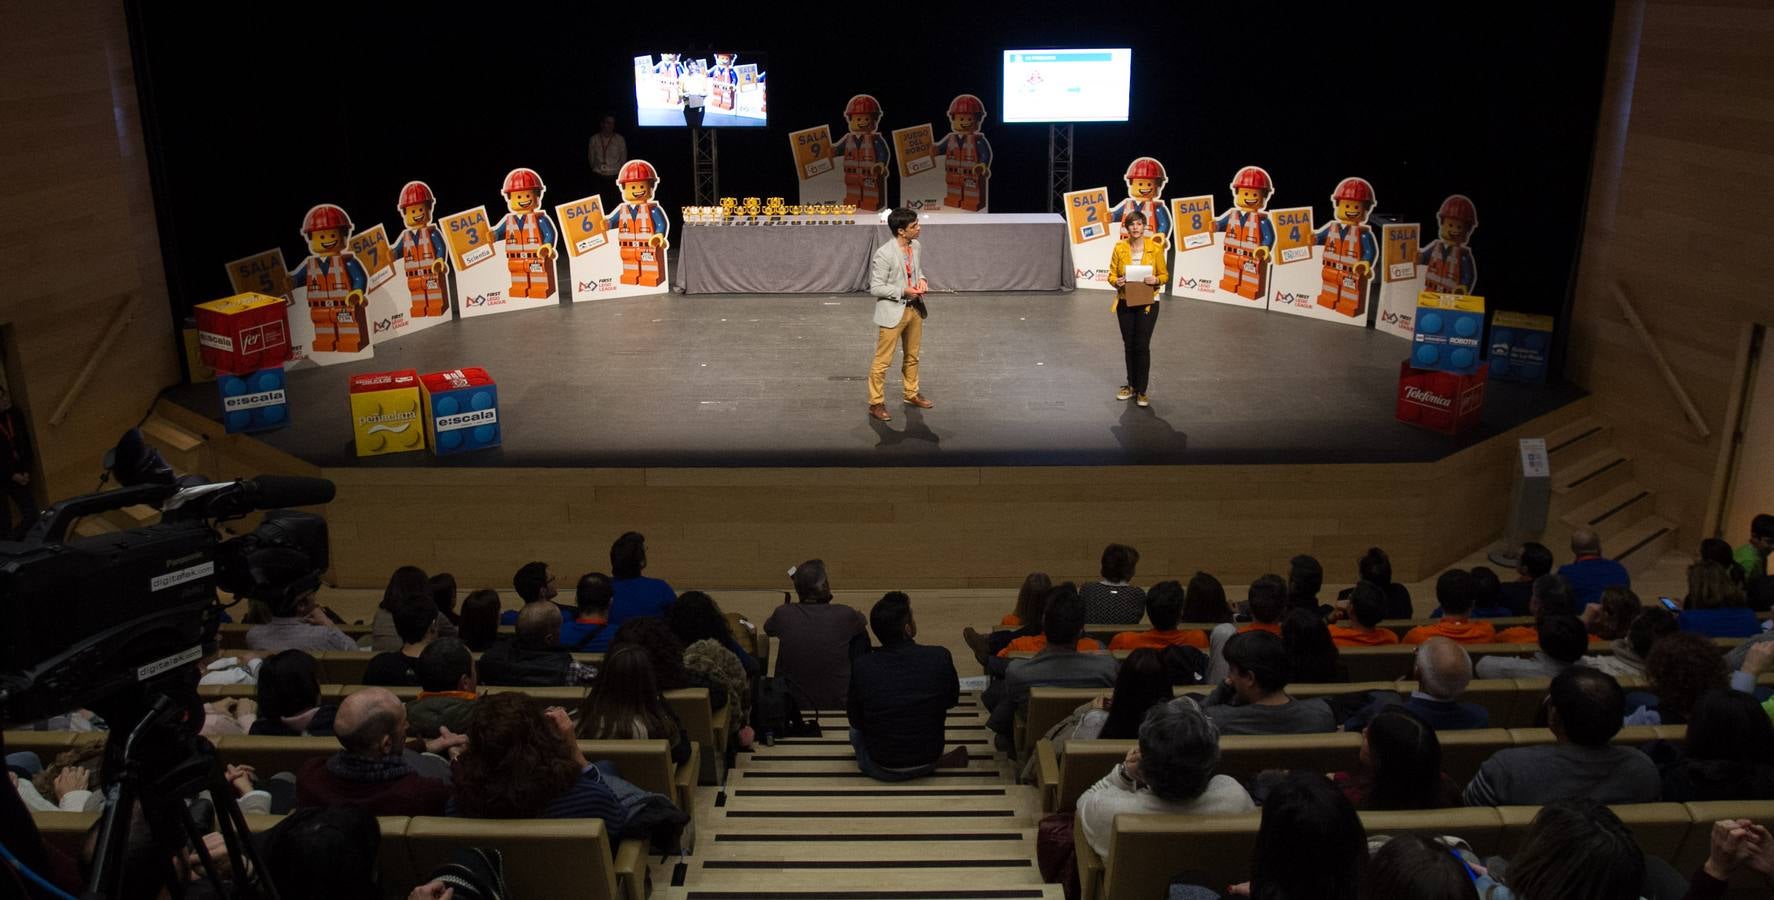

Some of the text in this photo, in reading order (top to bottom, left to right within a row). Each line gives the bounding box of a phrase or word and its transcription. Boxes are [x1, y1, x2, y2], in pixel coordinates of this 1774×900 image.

[798, 130, 828, 146] SALA
[811, 143, 821, 158] 9
[1073, 193, 1104, 208] SALA
[1180, 201, 1210, 214] SALA
[566, 202, 599, 219] SALA
[1086, 206, 1097, 222] 2
[450, 213, 485, 232] SALA
[581, 216, 593, 233] 6
[1191, 214, 1202, 230] 8
[1278, 213, 1309, 226] SALA
[466, 228, 479, 245] 3
[1289, 226, 1301, 242] 4
[1390, 230, 1416, 240] SALA
[353, 232, 384, 253] SALA
[367, 248, 378, 267] 7
[466, 250, 490, 264] Scientia
[1400, 243, 1406, 260] 1
[239, 256, 281, 279] SALA
[259, 270, 273, 293] 5
[227, 391, 283, 407] e:scala
[1405, 385, 1452, 407] Telefónica
[438, 410, 495, 428] e:scala
